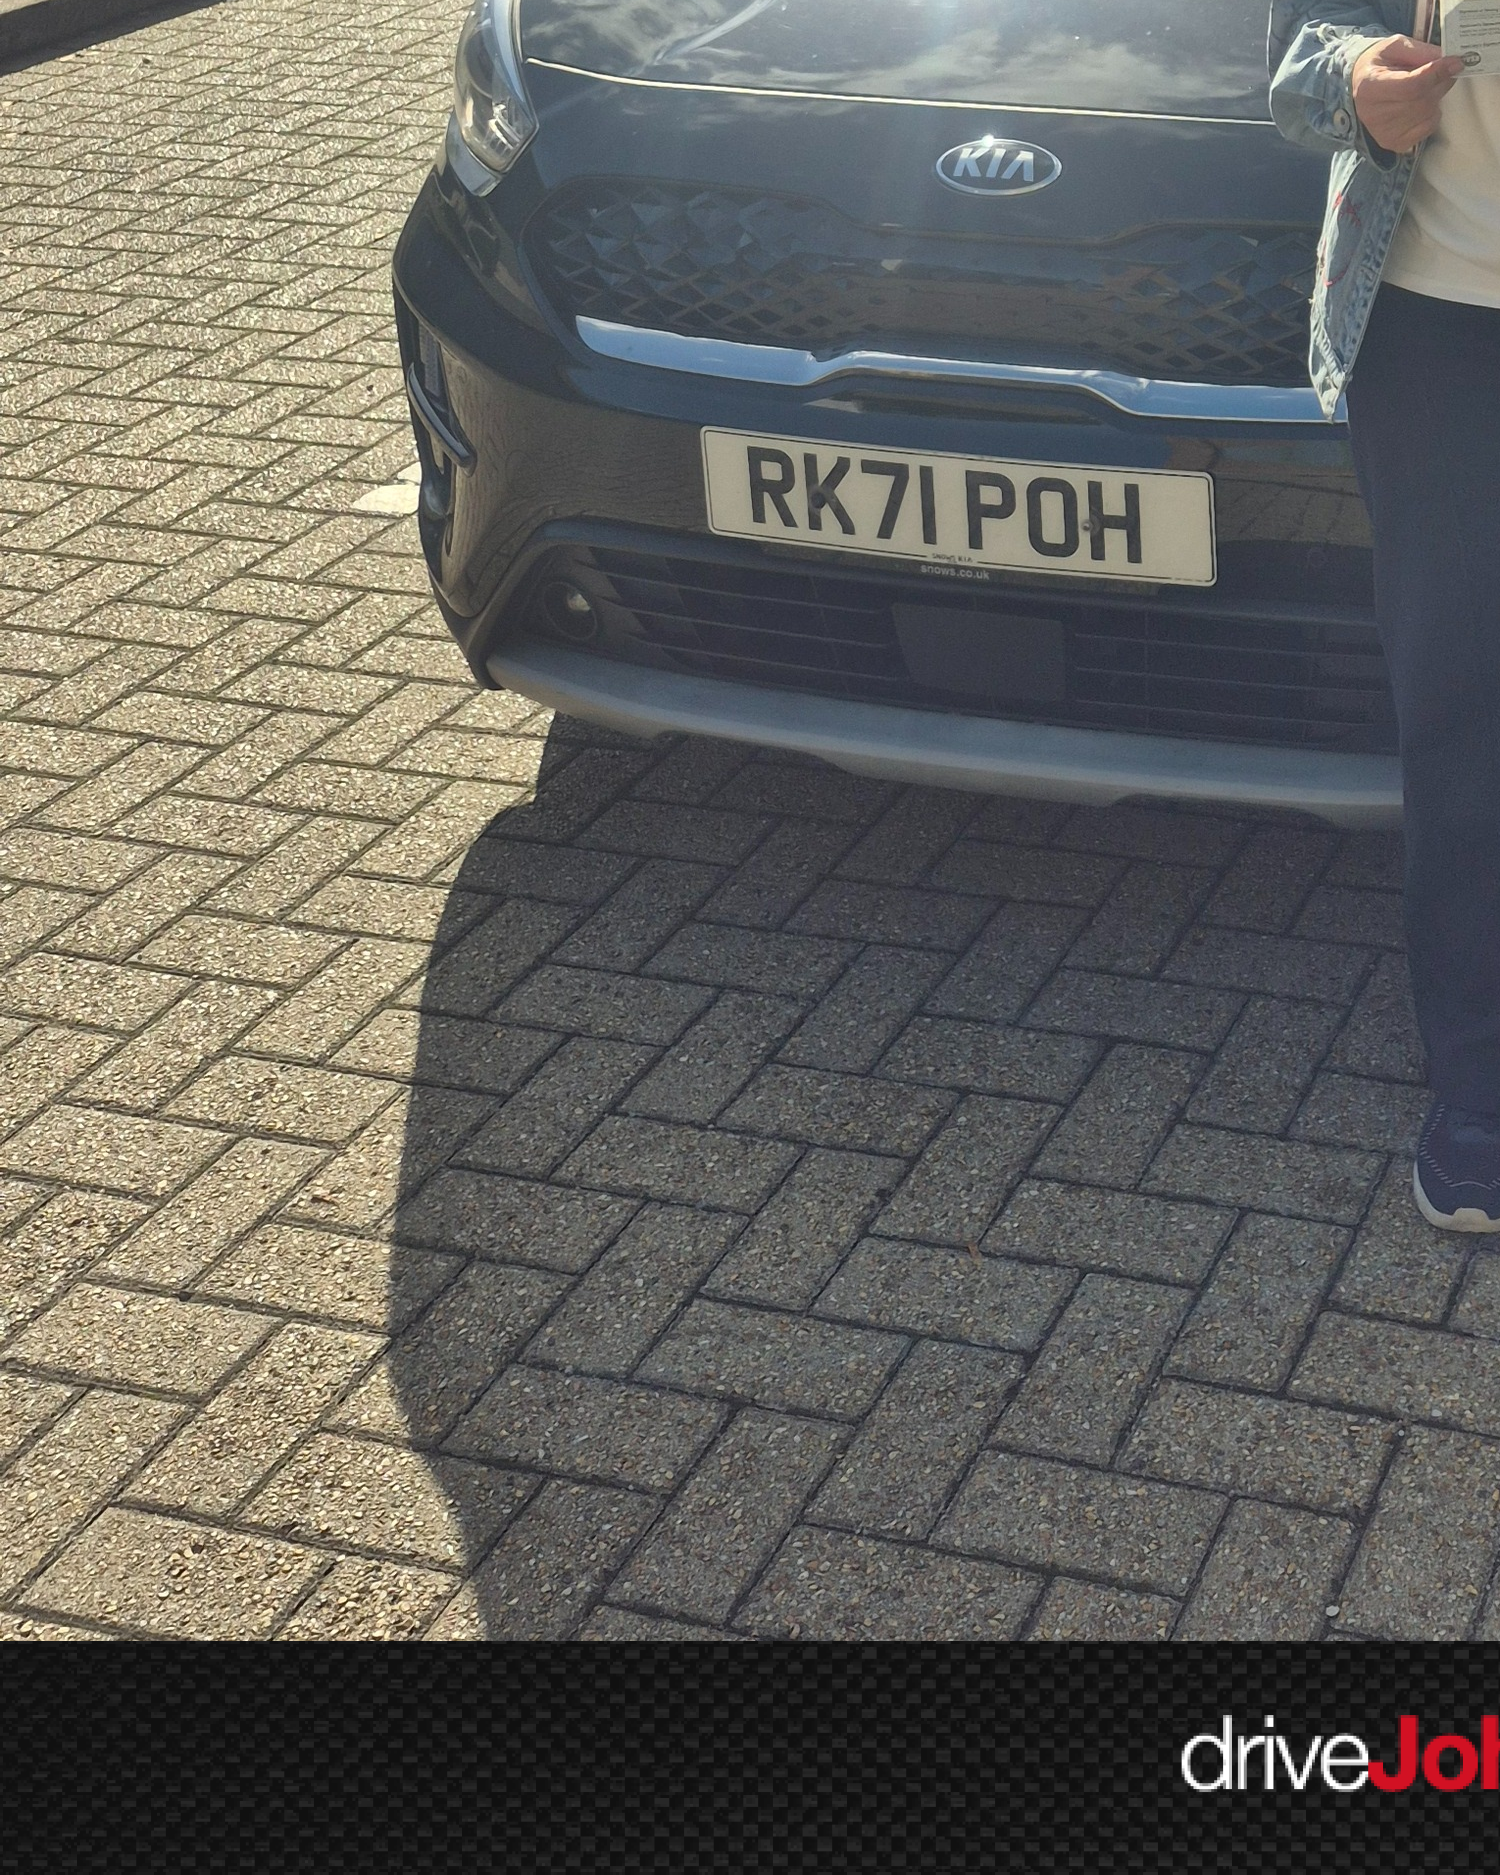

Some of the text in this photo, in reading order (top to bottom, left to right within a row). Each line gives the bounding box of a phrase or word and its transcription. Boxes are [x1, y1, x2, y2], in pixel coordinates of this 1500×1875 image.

[952, 147, 1034, 182] KIA
[746, 444, 1143, 564] RK71 POH
[920, 564, 990, 580] snows.co.uk
